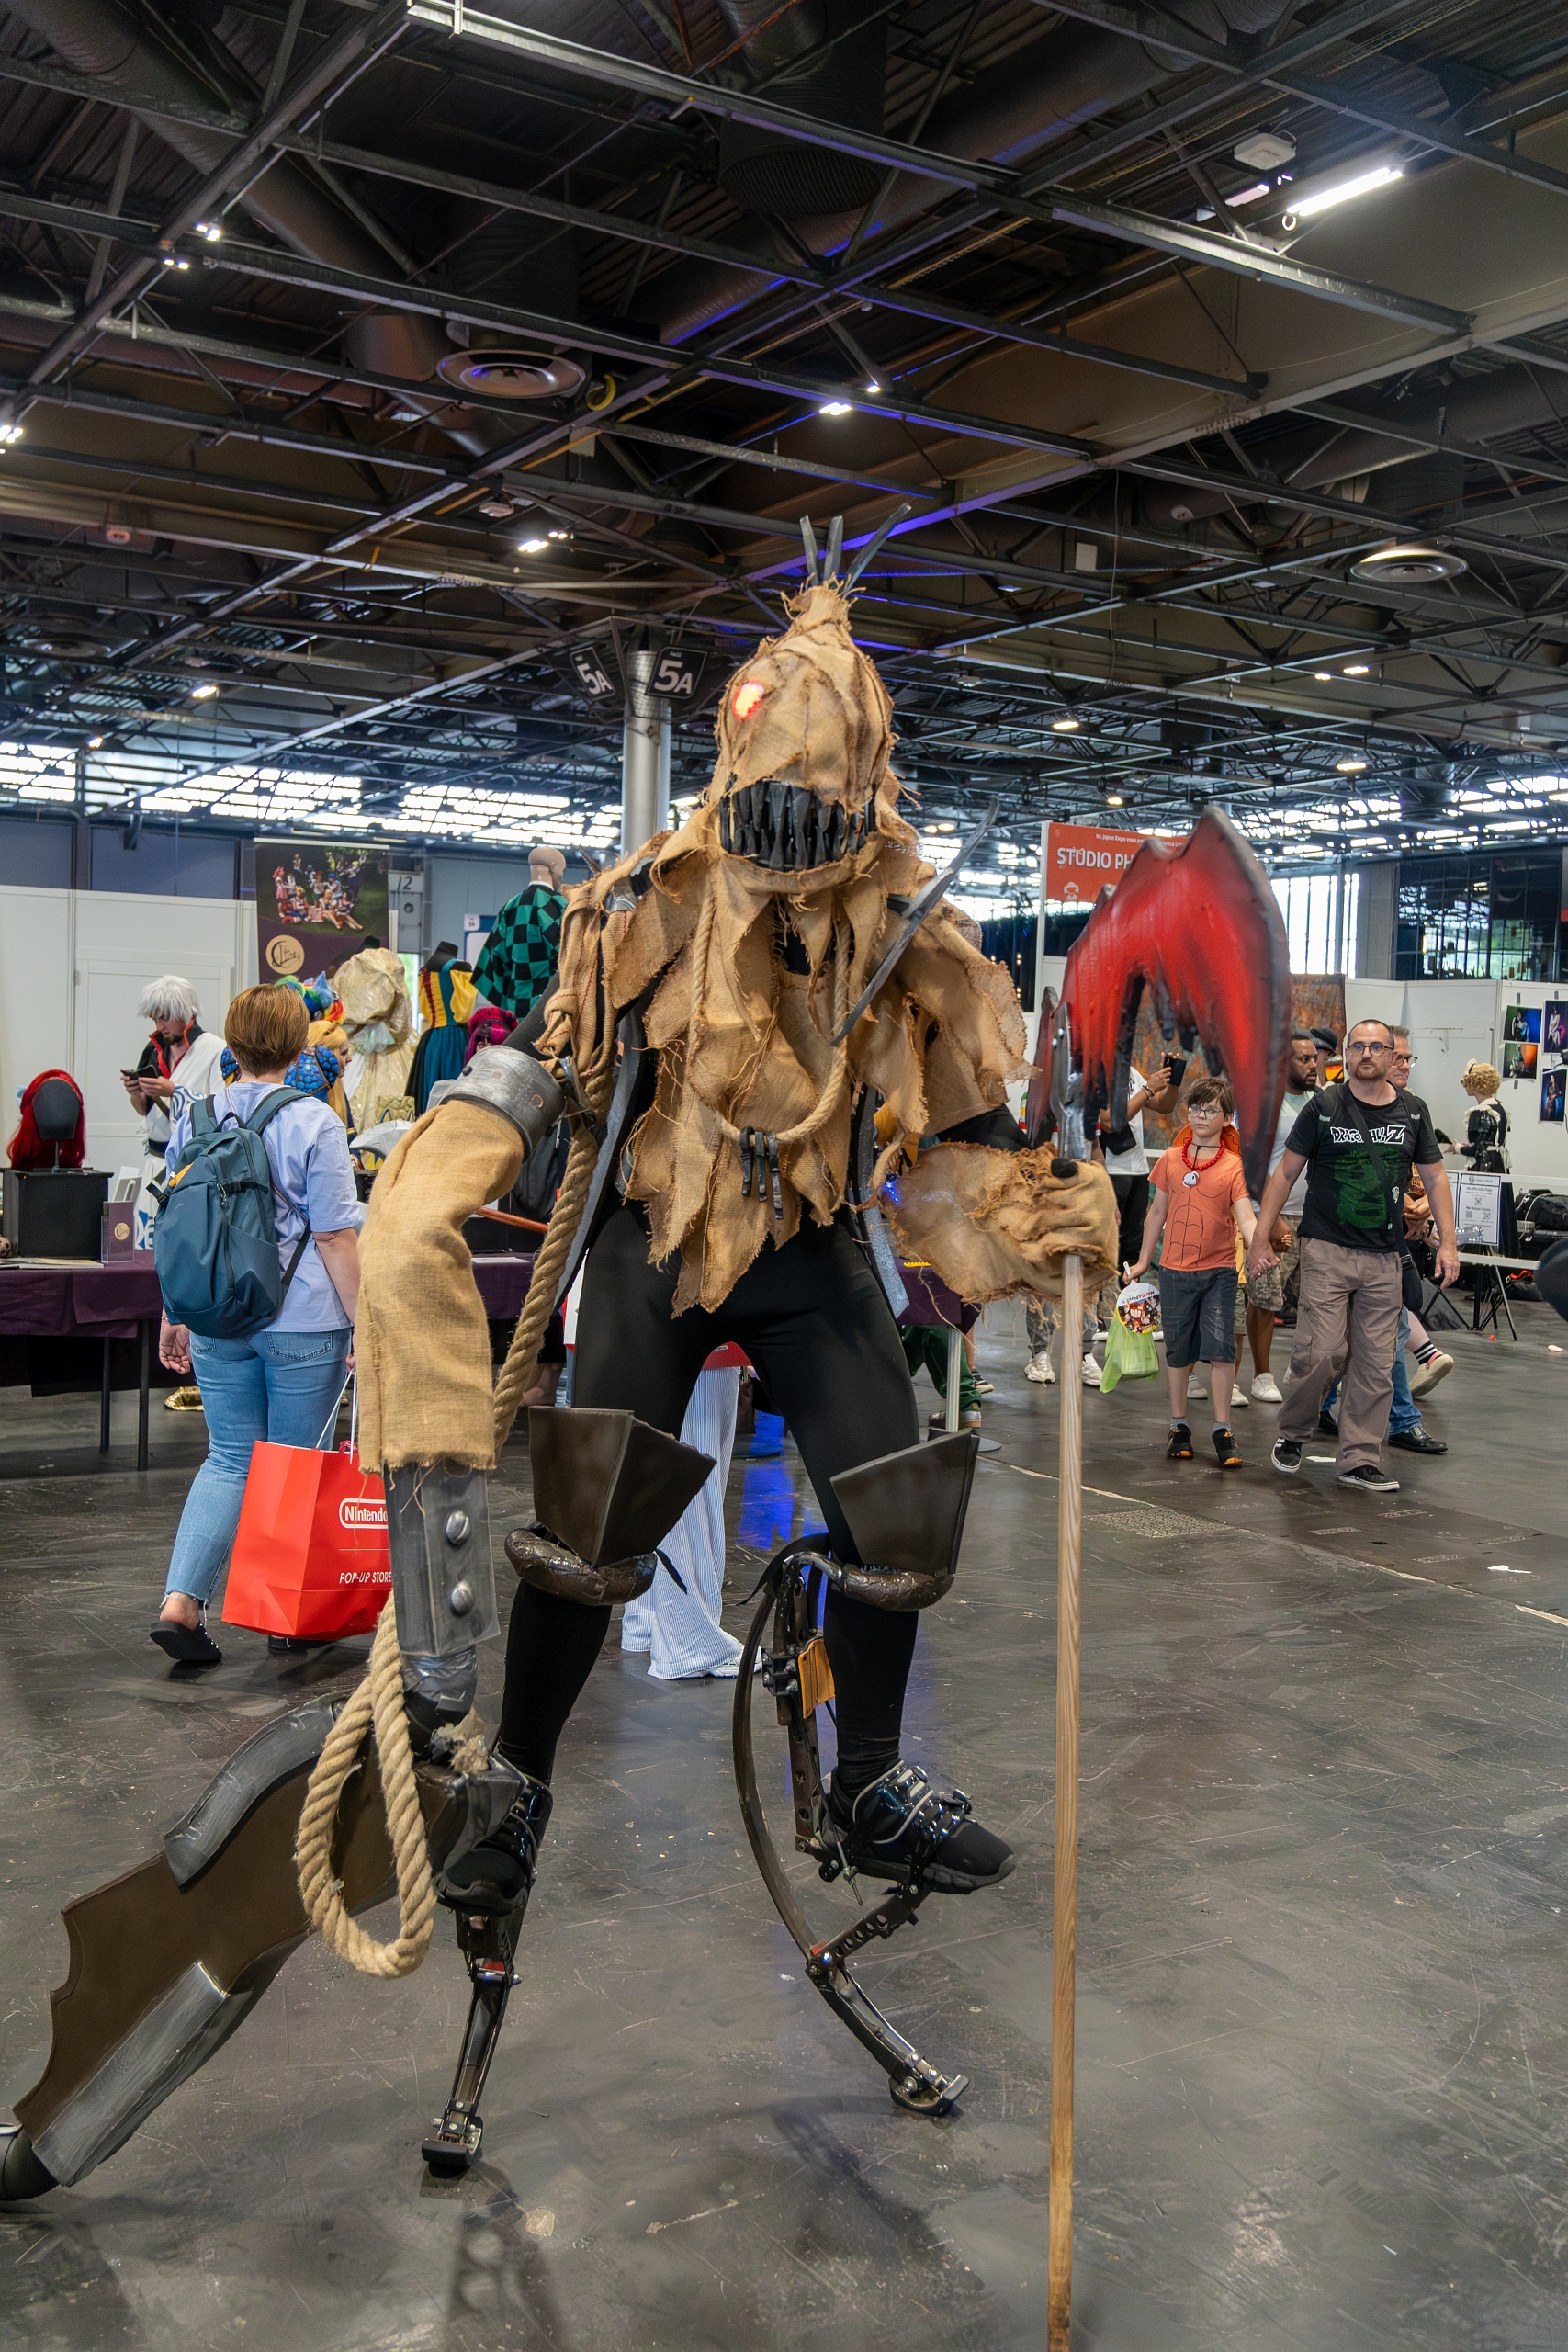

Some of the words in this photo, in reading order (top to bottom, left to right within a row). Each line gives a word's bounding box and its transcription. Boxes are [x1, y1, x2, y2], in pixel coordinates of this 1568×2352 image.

[576, 662, 613, 695] 5A
[653, 659, 694, 695] 5A
[1056, 847, 1111, 869] STUDIO
[1114, 854, 1134, 870] PH
[1329, 1126, 1365, 1144] DRAGO
[344, 1505, 389, 1522] Nintendo
[338, 1572, 371, 1585] POP-UP
[371, 1571, 393, 1584] STORE
